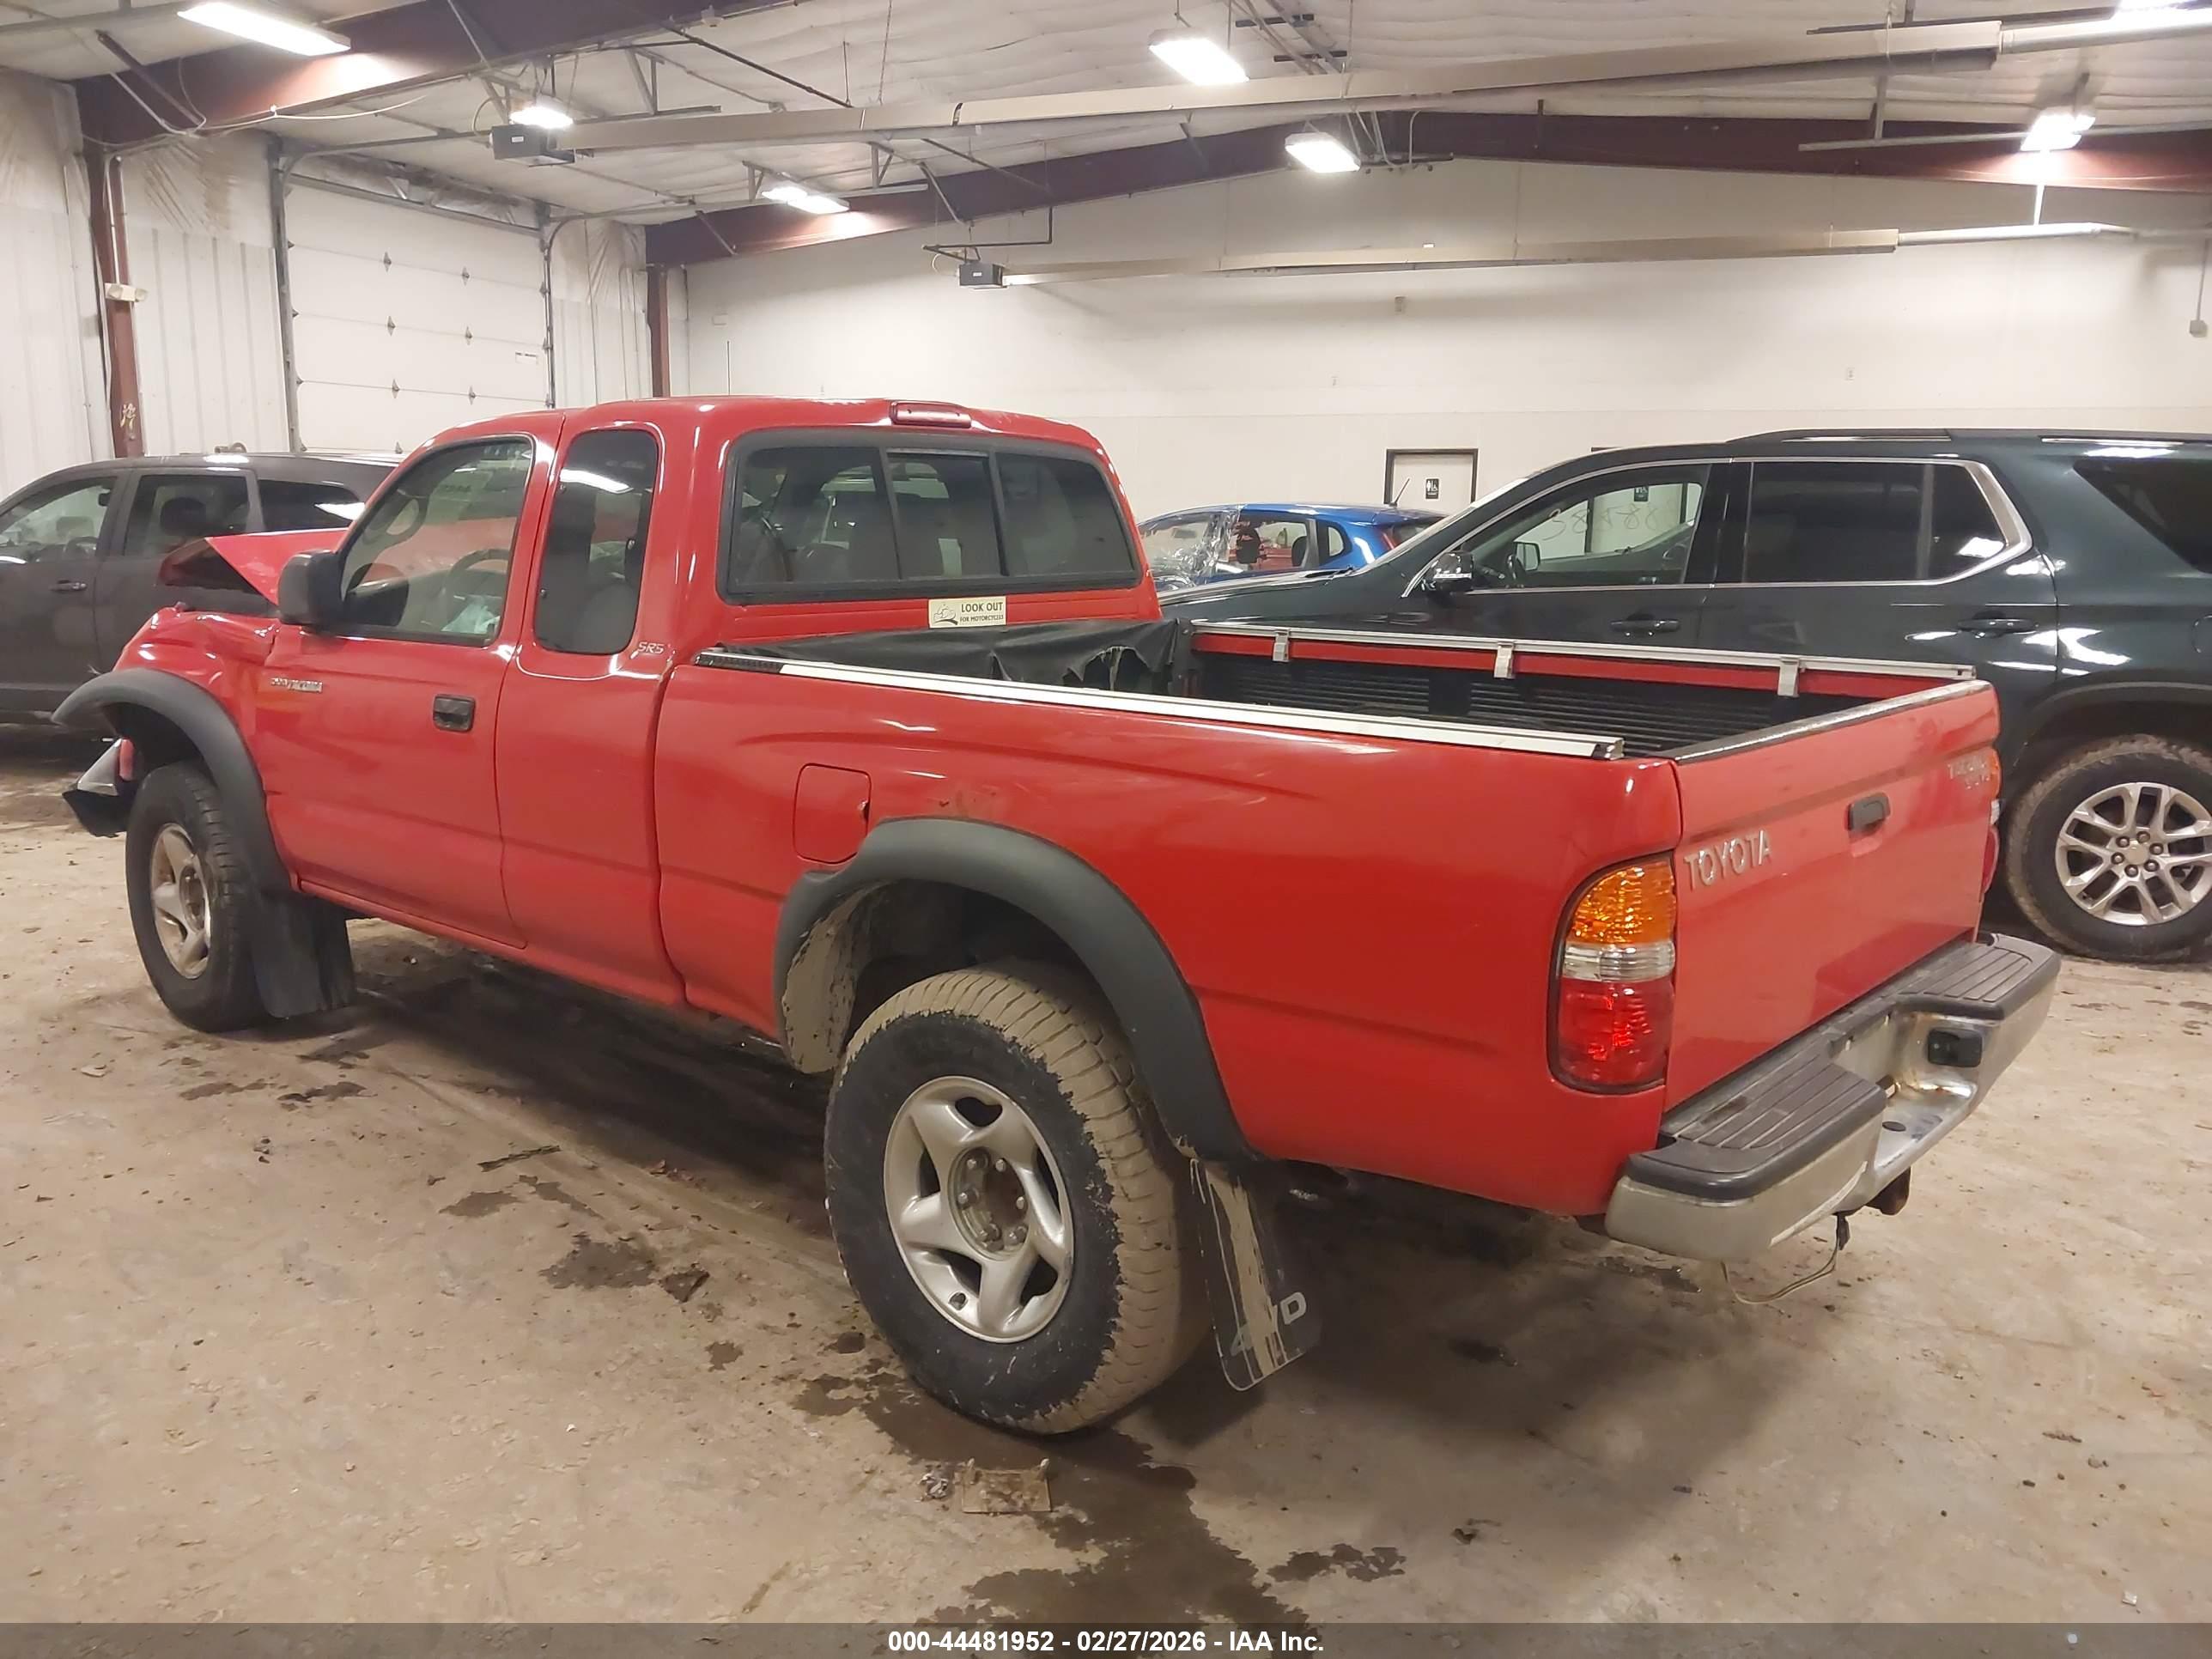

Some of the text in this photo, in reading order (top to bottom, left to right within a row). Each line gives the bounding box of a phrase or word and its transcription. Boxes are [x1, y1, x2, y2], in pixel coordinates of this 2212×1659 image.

[961, 602, 1003, 613] LOOK OUT
[637, 641, 665, 654] SR5
[1684, 830, 1771, 891] TOYOTA
